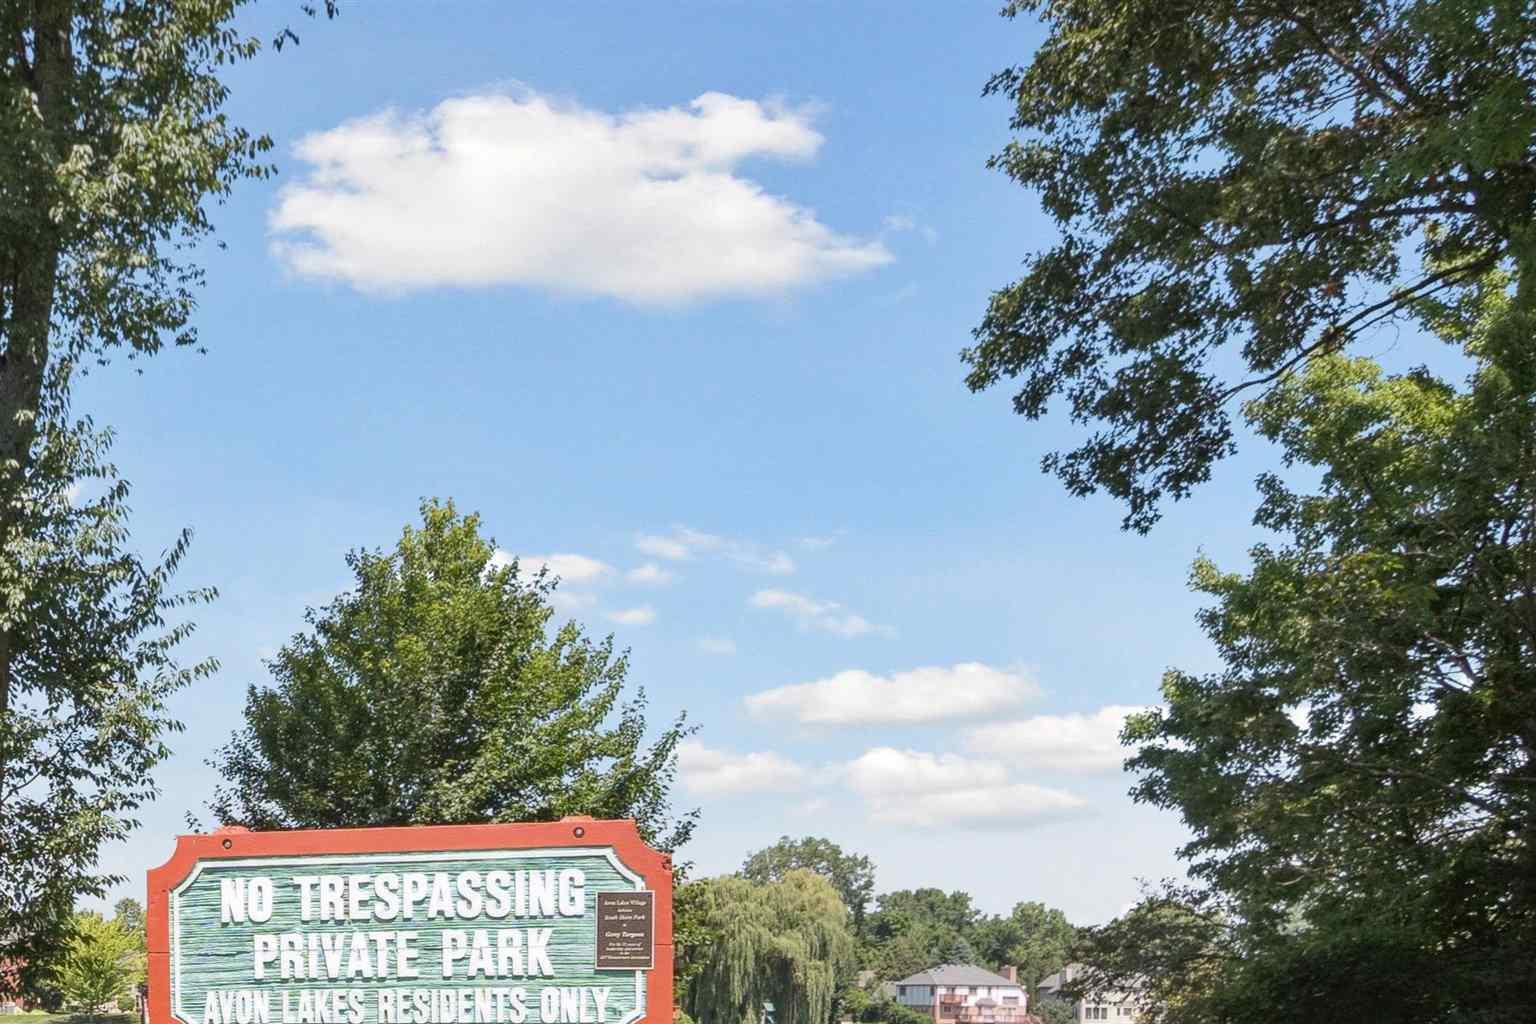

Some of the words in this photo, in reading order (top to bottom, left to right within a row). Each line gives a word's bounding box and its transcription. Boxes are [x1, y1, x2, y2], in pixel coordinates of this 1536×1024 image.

[221, 877, 272, 923] NO
[293, 869, 585, 921] TRESPASSING
[254, 931, 419, 979] PRIVATE
[442, 928, 554, 977] PARK
[203, 990, 270, 1024] AVON
[282, 989, 363, 1024] LAKES
[378, 988, 527, 1024] RESIDENTS
[540, 987, 610, 1024] ONLY
